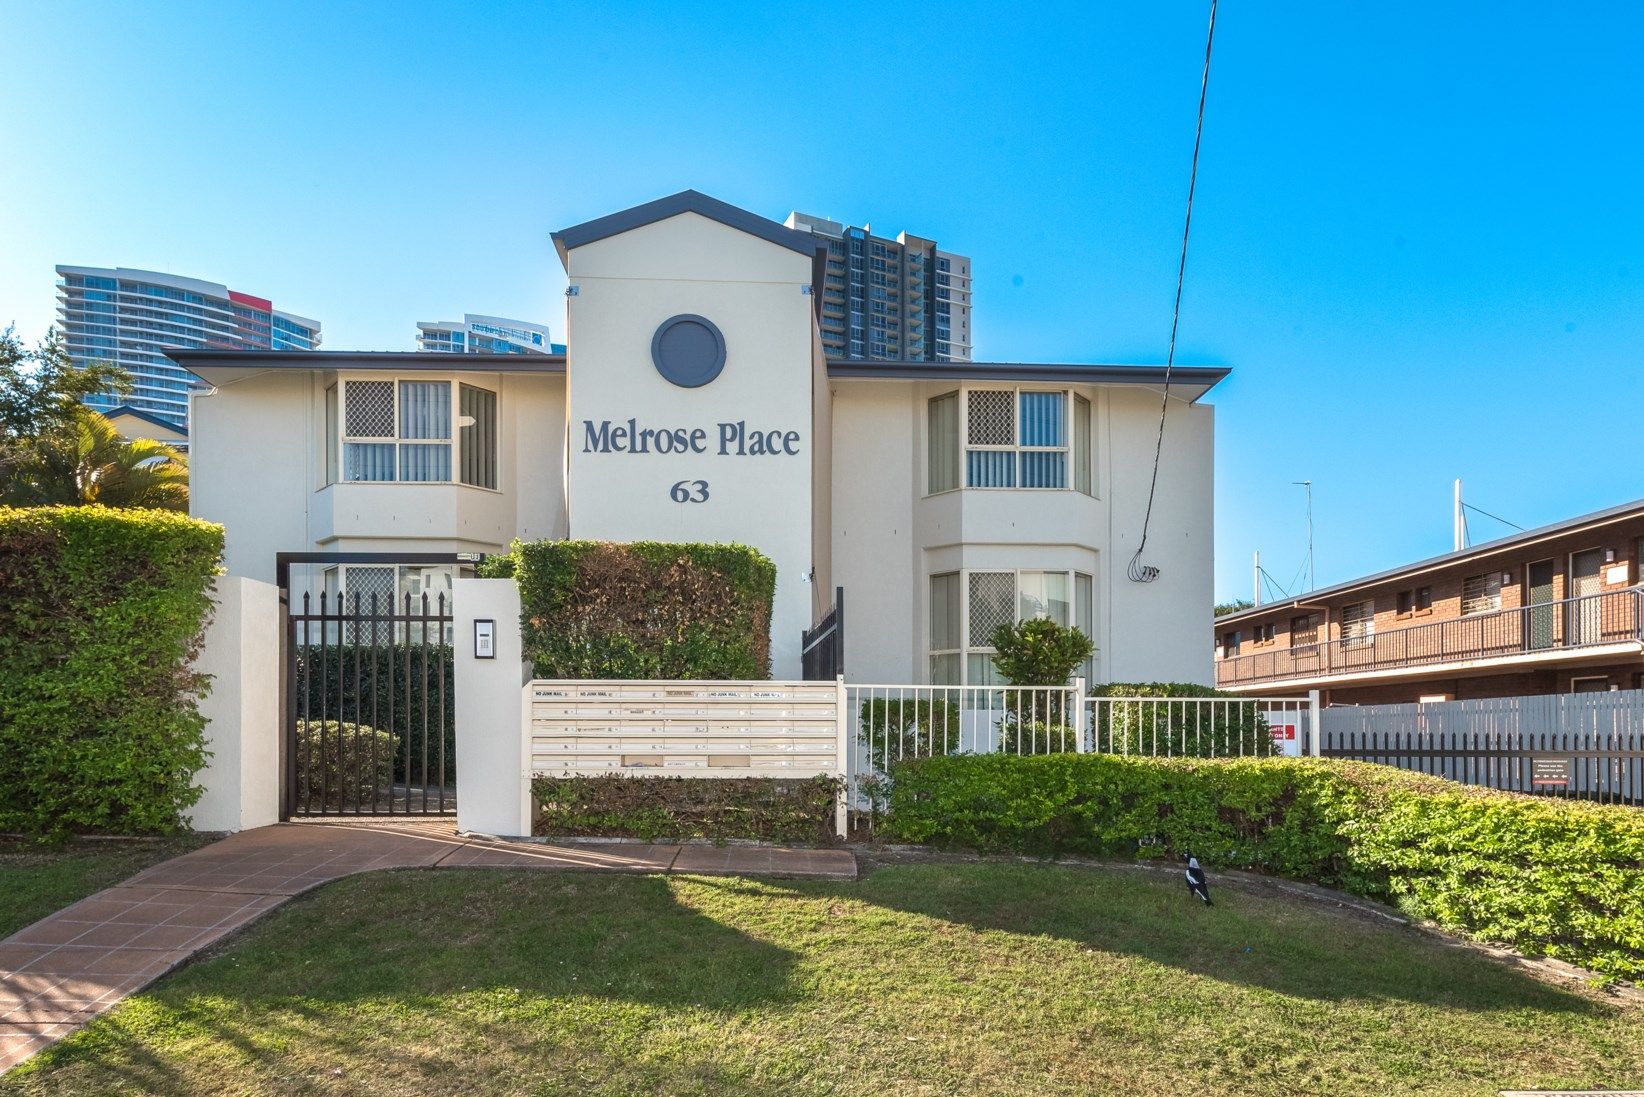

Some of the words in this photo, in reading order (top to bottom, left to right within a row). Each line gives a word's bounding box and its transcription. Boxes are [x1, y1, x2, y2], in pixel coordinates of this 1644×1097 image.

[582, 418, 707, 454] Melrose
[717, 420, 800, 456] Place
[670, 479, 710, 503] 63
